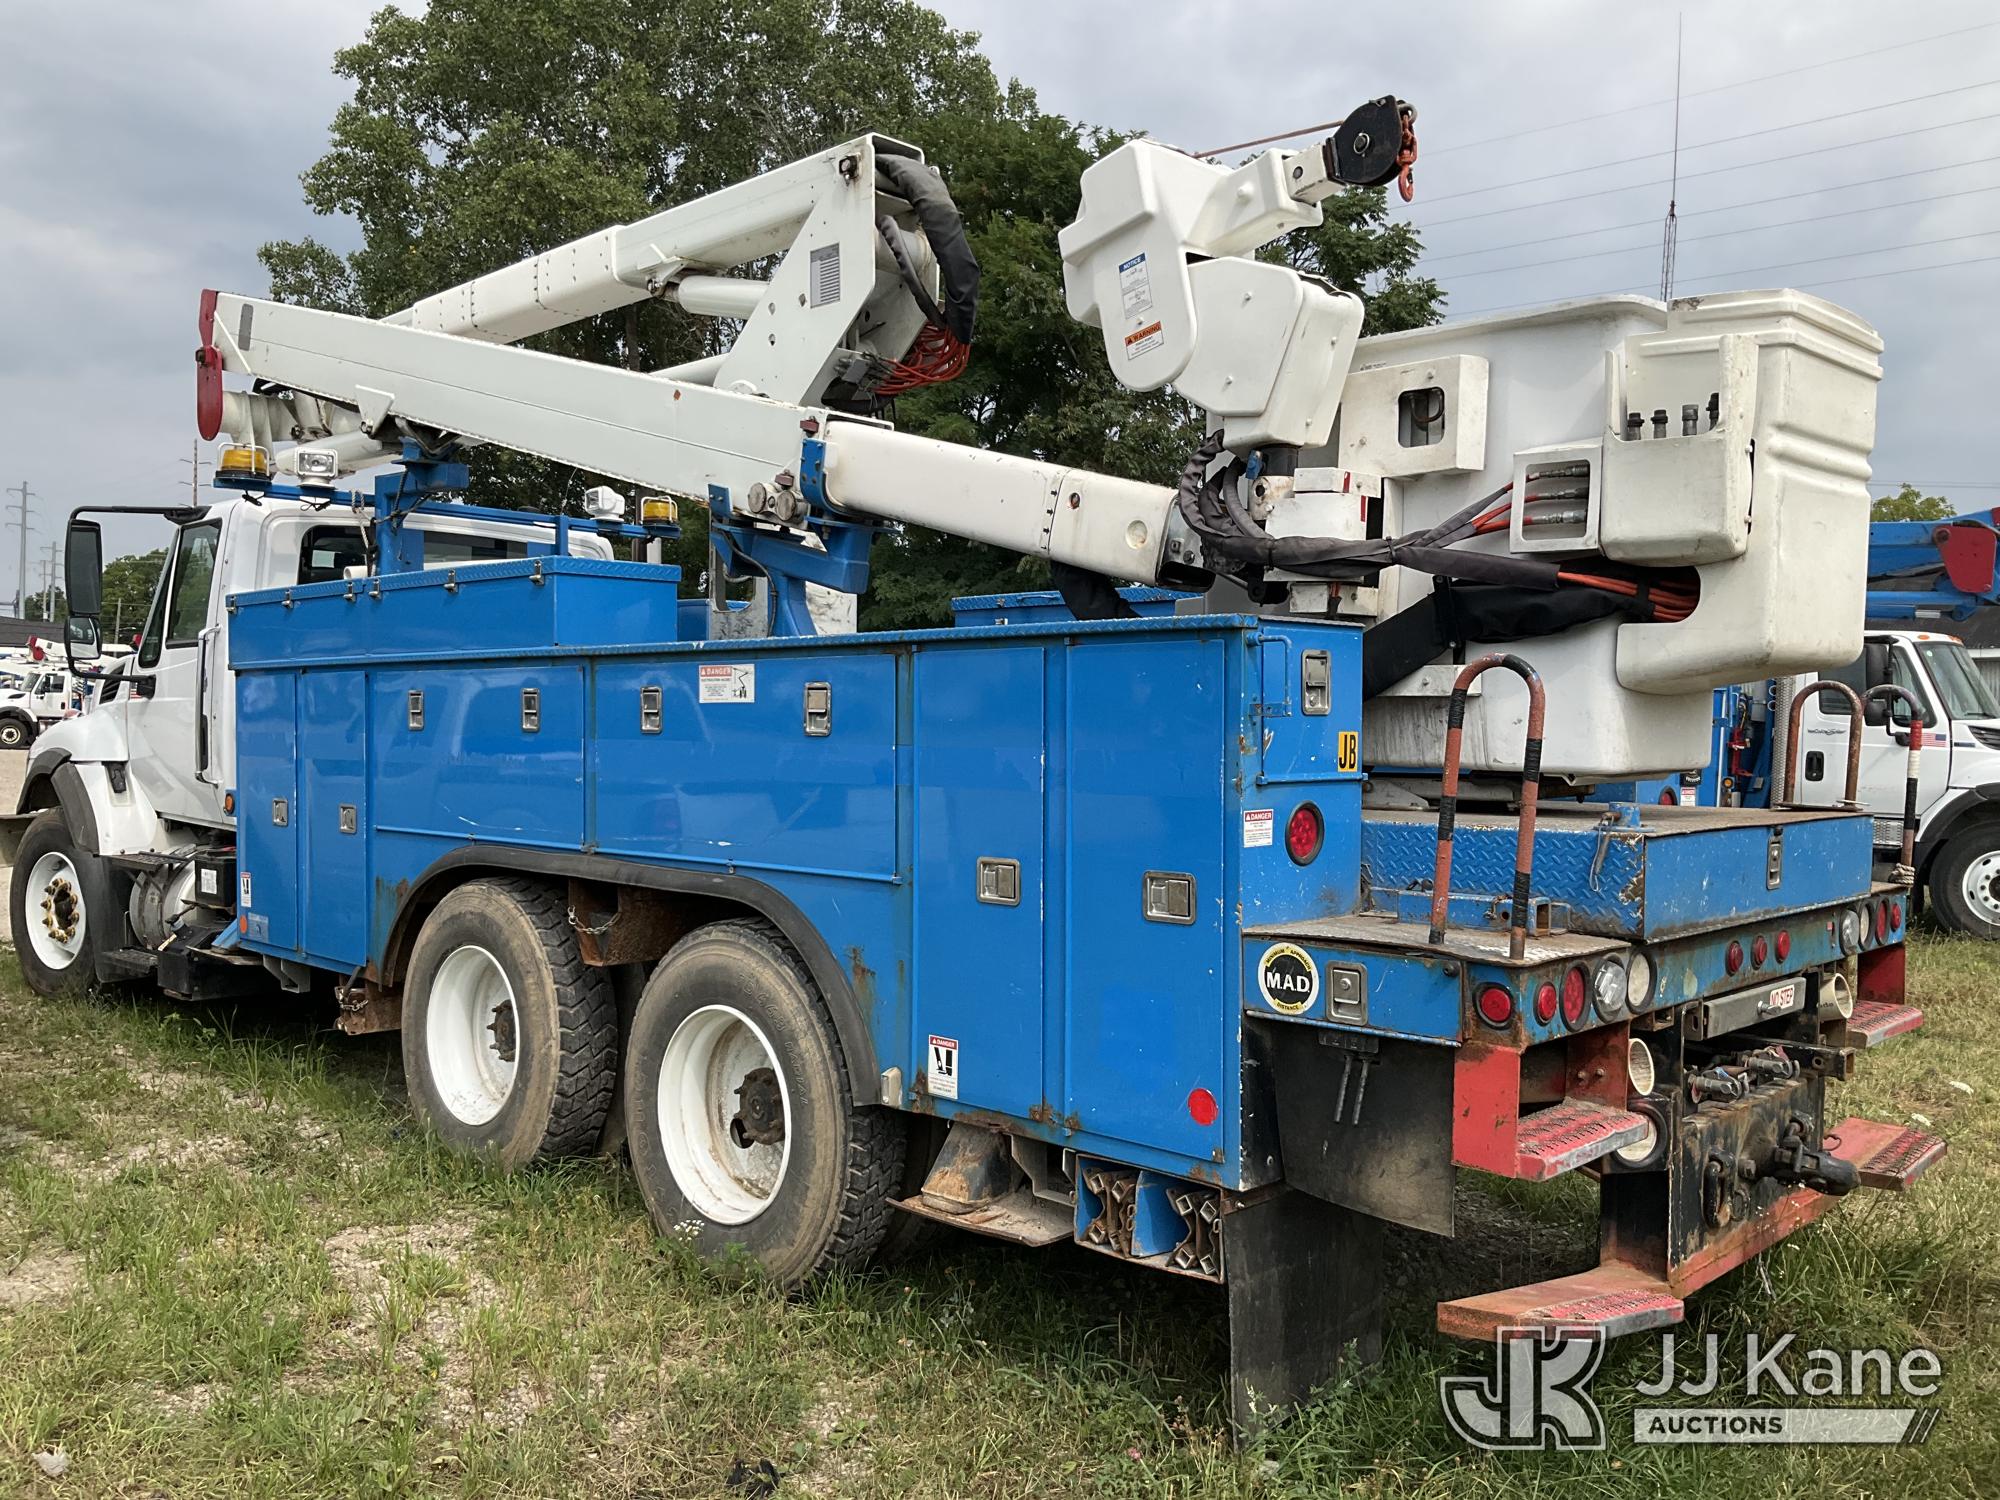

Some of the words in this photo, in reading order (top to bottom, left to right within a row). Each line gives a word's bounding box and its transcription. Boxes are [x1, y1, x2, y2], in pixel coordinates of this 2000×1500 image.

[1123, 256, 1142, 270] NOTICE
[1133, 325, 1160, 341] WARNING
[706, 667, 731, 676] DANGER
[1339, 734, 1356, 769] JB
[1250, 812, 1272, 820] DANGER
[1265, 948, 1286, 964] MINIMUM
[1290, 949, 1312, 970] APPROACH
[1266, 971, 1311, 993] M.A.D.
[1771, 991, 1780, 1006] NO
[1780, 986, 1794, 1007] STEP
[1276, 1002, 1299, 1011] DISTANCE
[936, 1039, 955, 1048] DANGER
